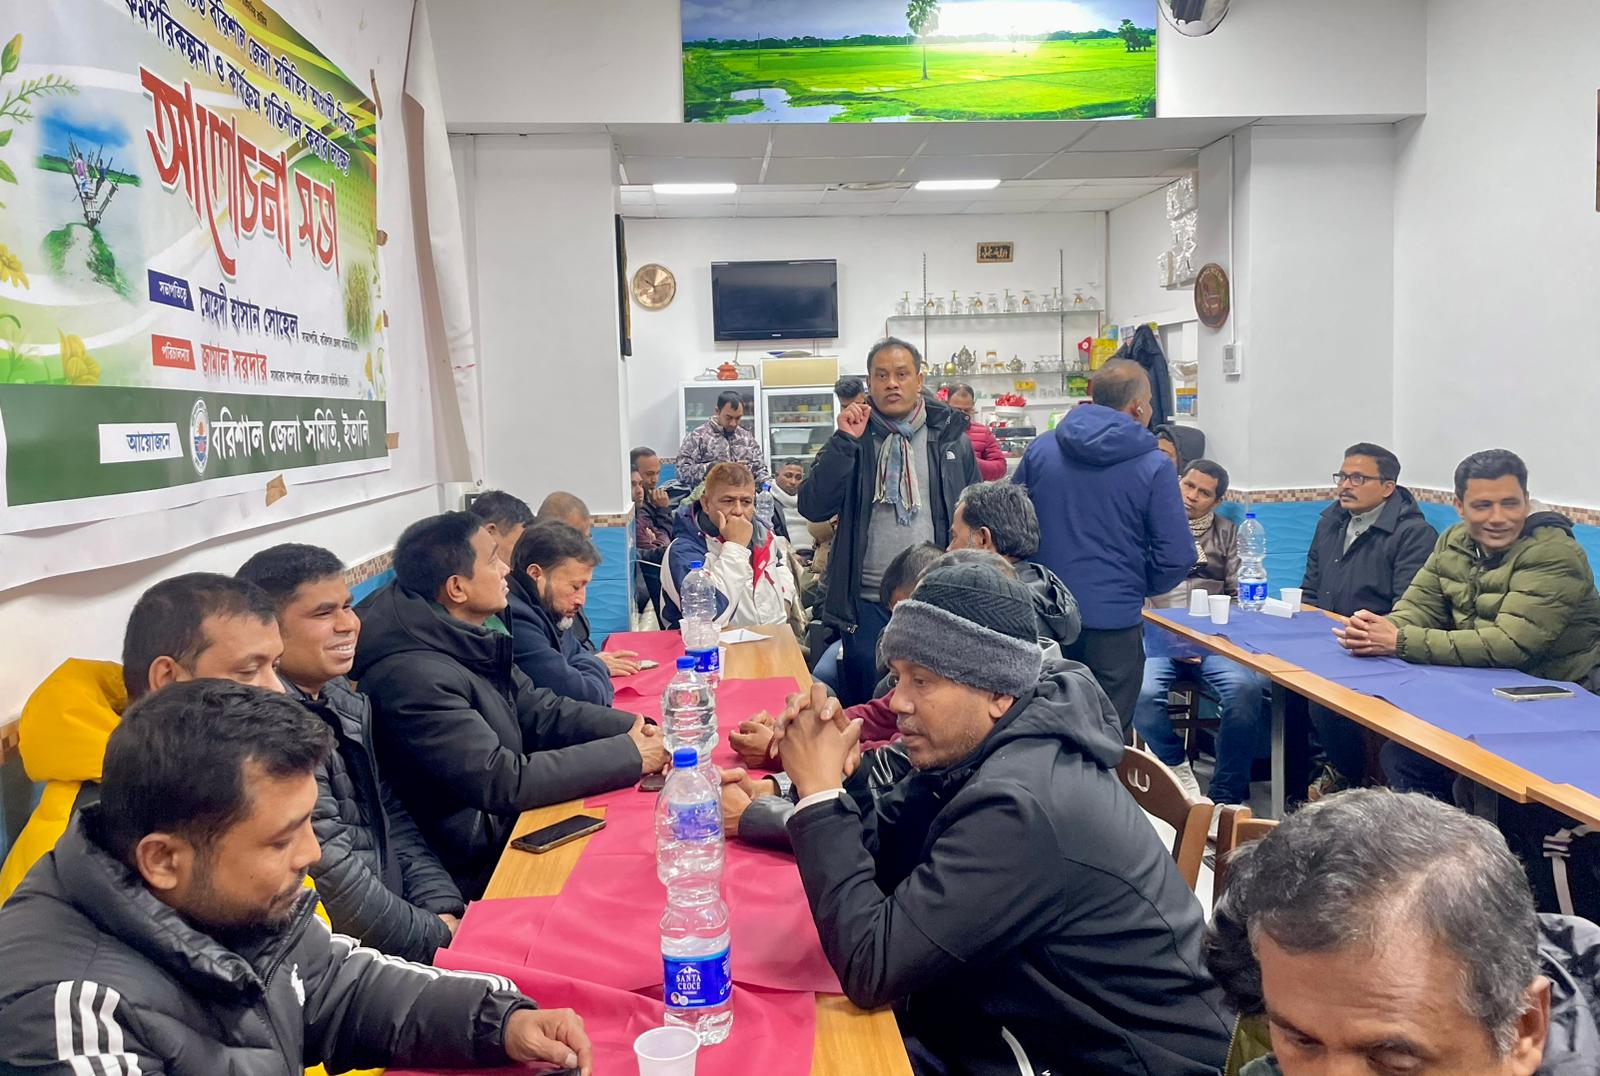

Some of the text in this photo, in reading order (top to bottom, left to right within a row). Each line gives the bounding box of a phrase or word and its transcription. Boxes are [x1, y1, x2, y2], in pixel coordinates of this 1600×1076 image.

[209, 0, 246, 48] বরিশাল
[249, 38, 272, 76] জেলা
[274, 56, 308, 101] সমিতির
[215, 55, 225, 82] ও
[227, 62, 260, 115] কার্যক্রম
[264, 92, 302, 146] গতিশীল
[305, 124, 329, 162] করার
[140, 66, 339, 277] আলোচনা সভা
[199, 283, 299, 341] মেহেদী হাসান সোহেল
[200, 340, 267, 381] জামাল সরদার
[126, 430, 171, 452] আয়োজনে
[211, 406, 265, 460] বরিশাল
[268, 415, 301, 454] জেলা
[302, 408, 341, 453] সমিতি,
[341, 408, 370, 451] ইতালি
[676, 974, 701, 983] SANTA
[677, 982, 701, 990] CROCE
